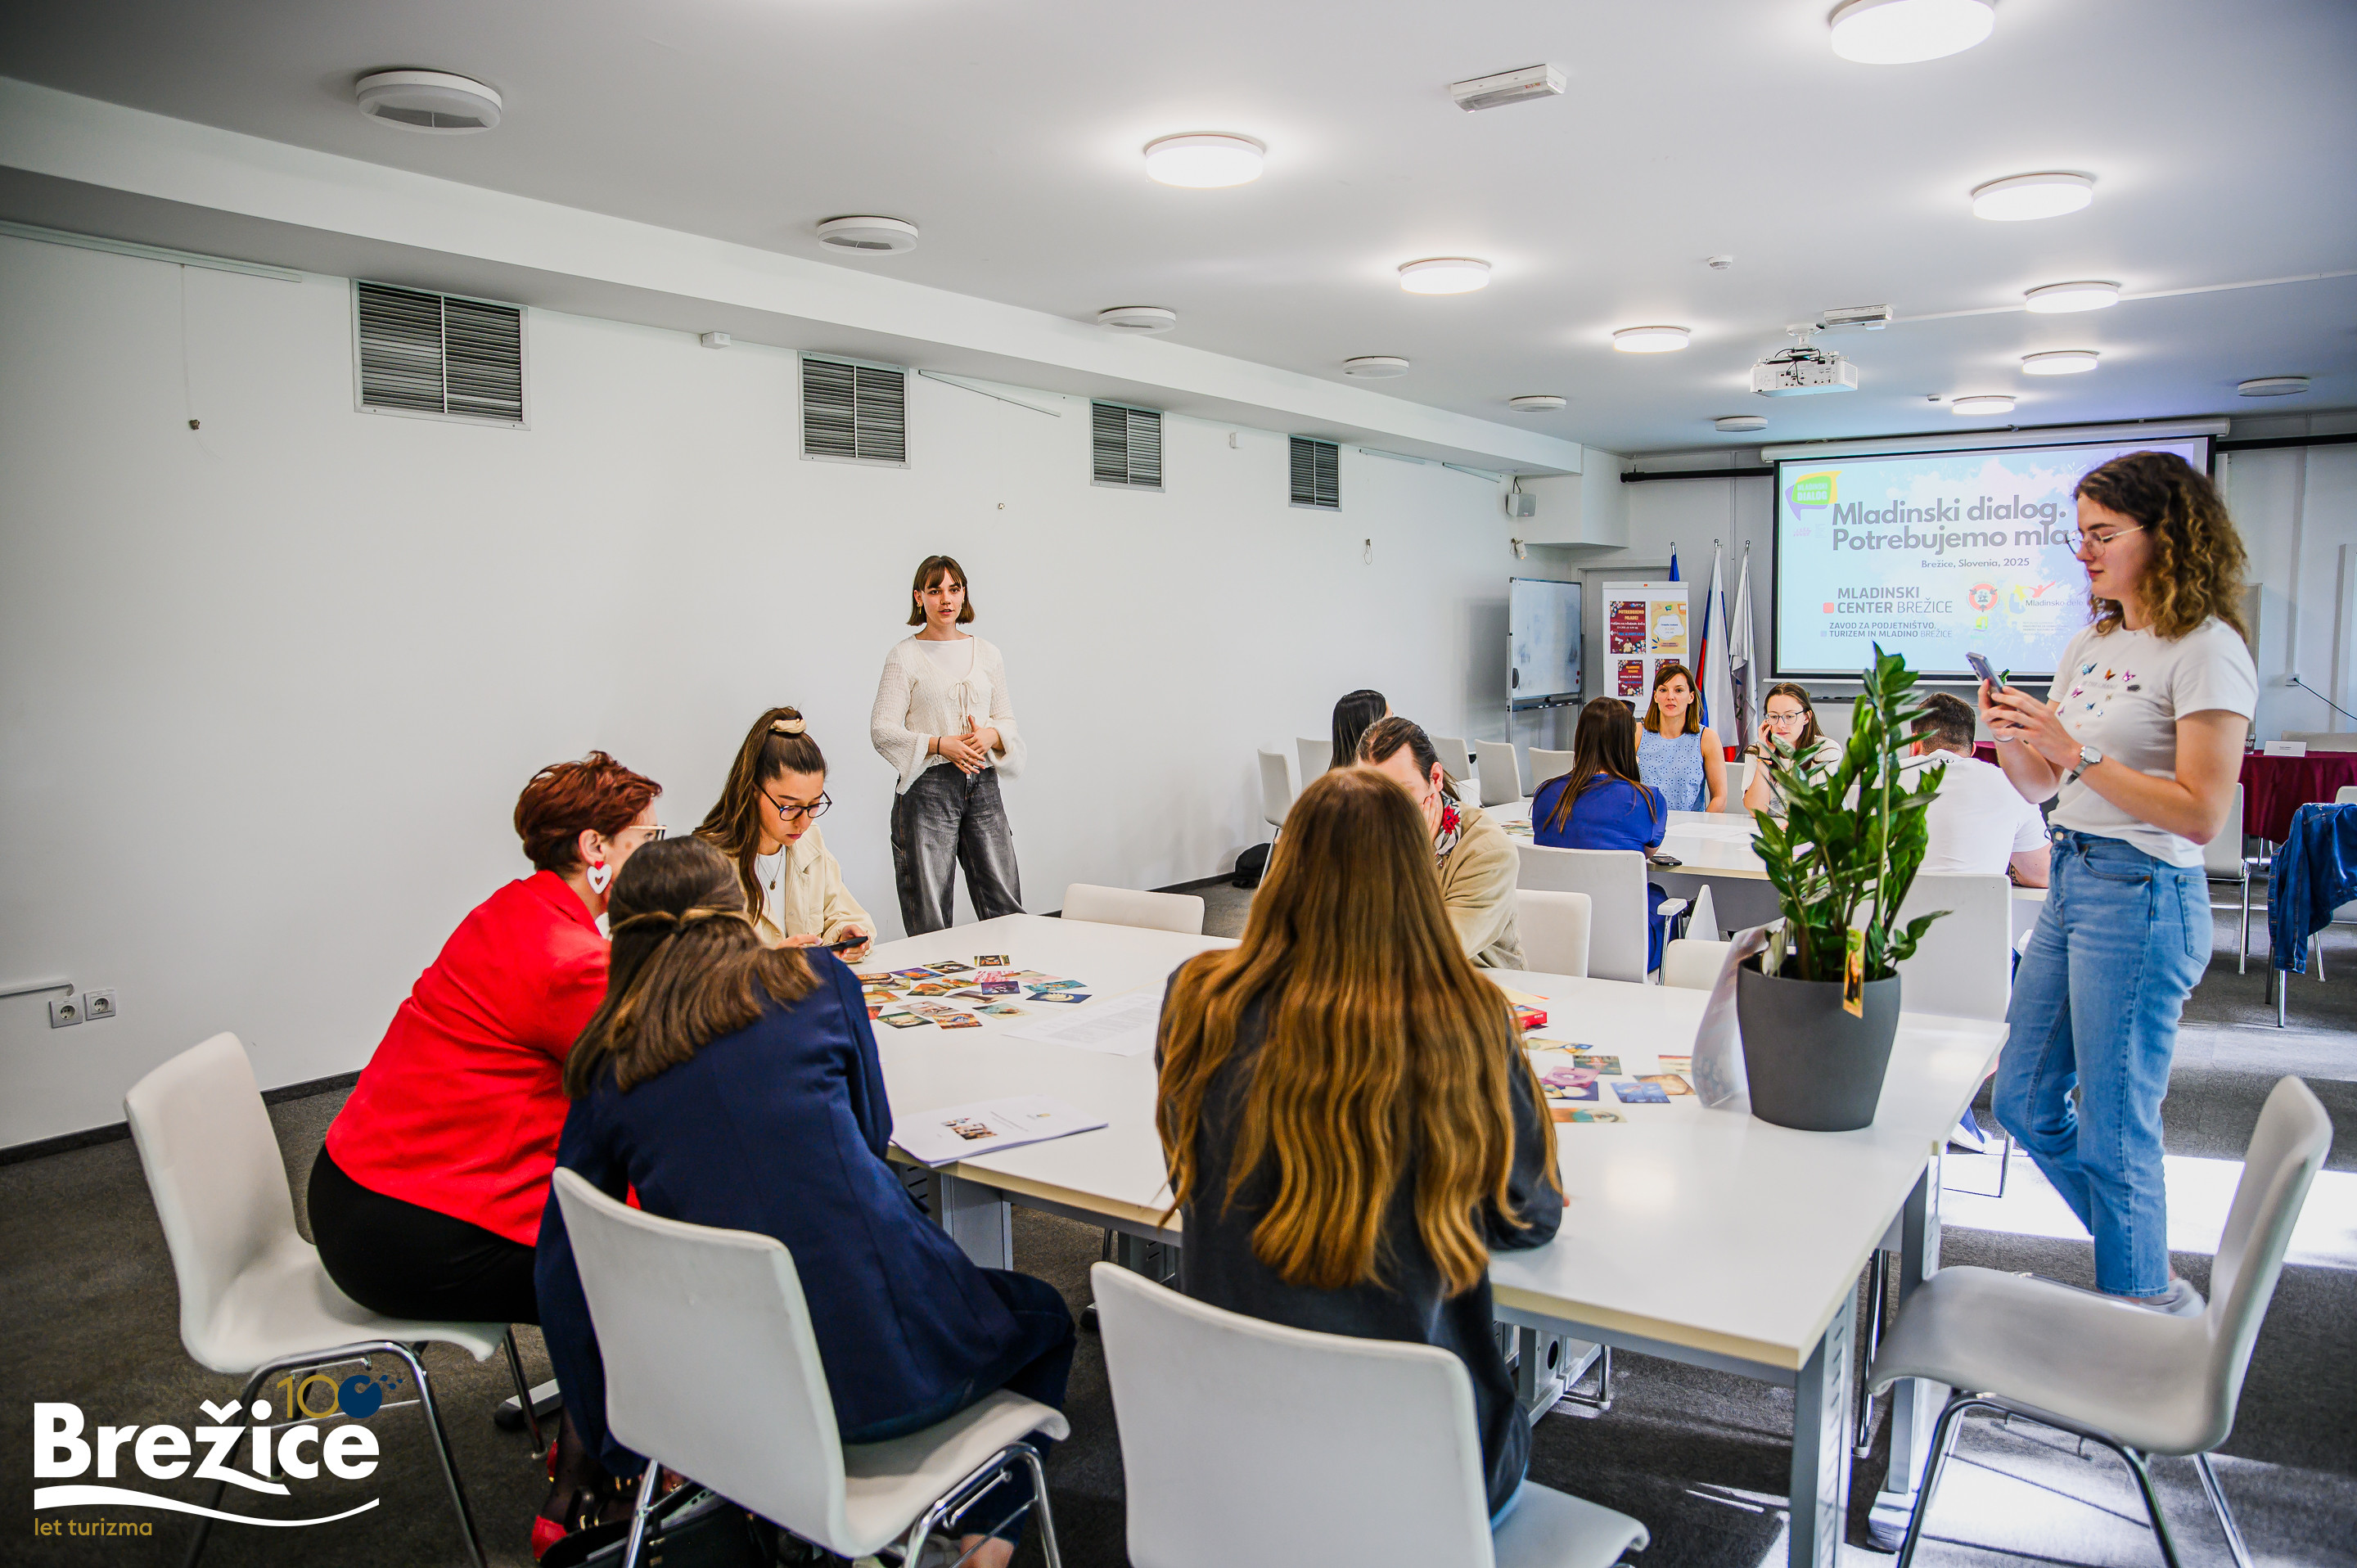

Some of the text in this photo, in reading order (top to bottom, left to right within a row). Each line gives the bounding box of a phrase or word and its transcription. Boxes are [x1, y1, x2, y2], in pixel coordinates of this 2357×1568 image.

[1796, 490, 1827, 502] DIALOG
[1832, 494, 2067, 525] Mladinski dialog.
[1832, 525, 2008, 556] Potrebujemo
[2014, 522, 2069, 547] mla
[1921, 557, 2030, 569] Brežice, Slovenia, 2025
[1837, 586, 1920, 599] MLADINSKI
[1837, 602, 1894, 614] CENTER
[1896, 597, 1954, 614] BREŽICE
[2025, 599, 2084, 607] Mladinsko delo
[1872, 620, 1937, 630] PODJETNIŠTVO,
[1920, 629, 1953, 638] BREŽICE
